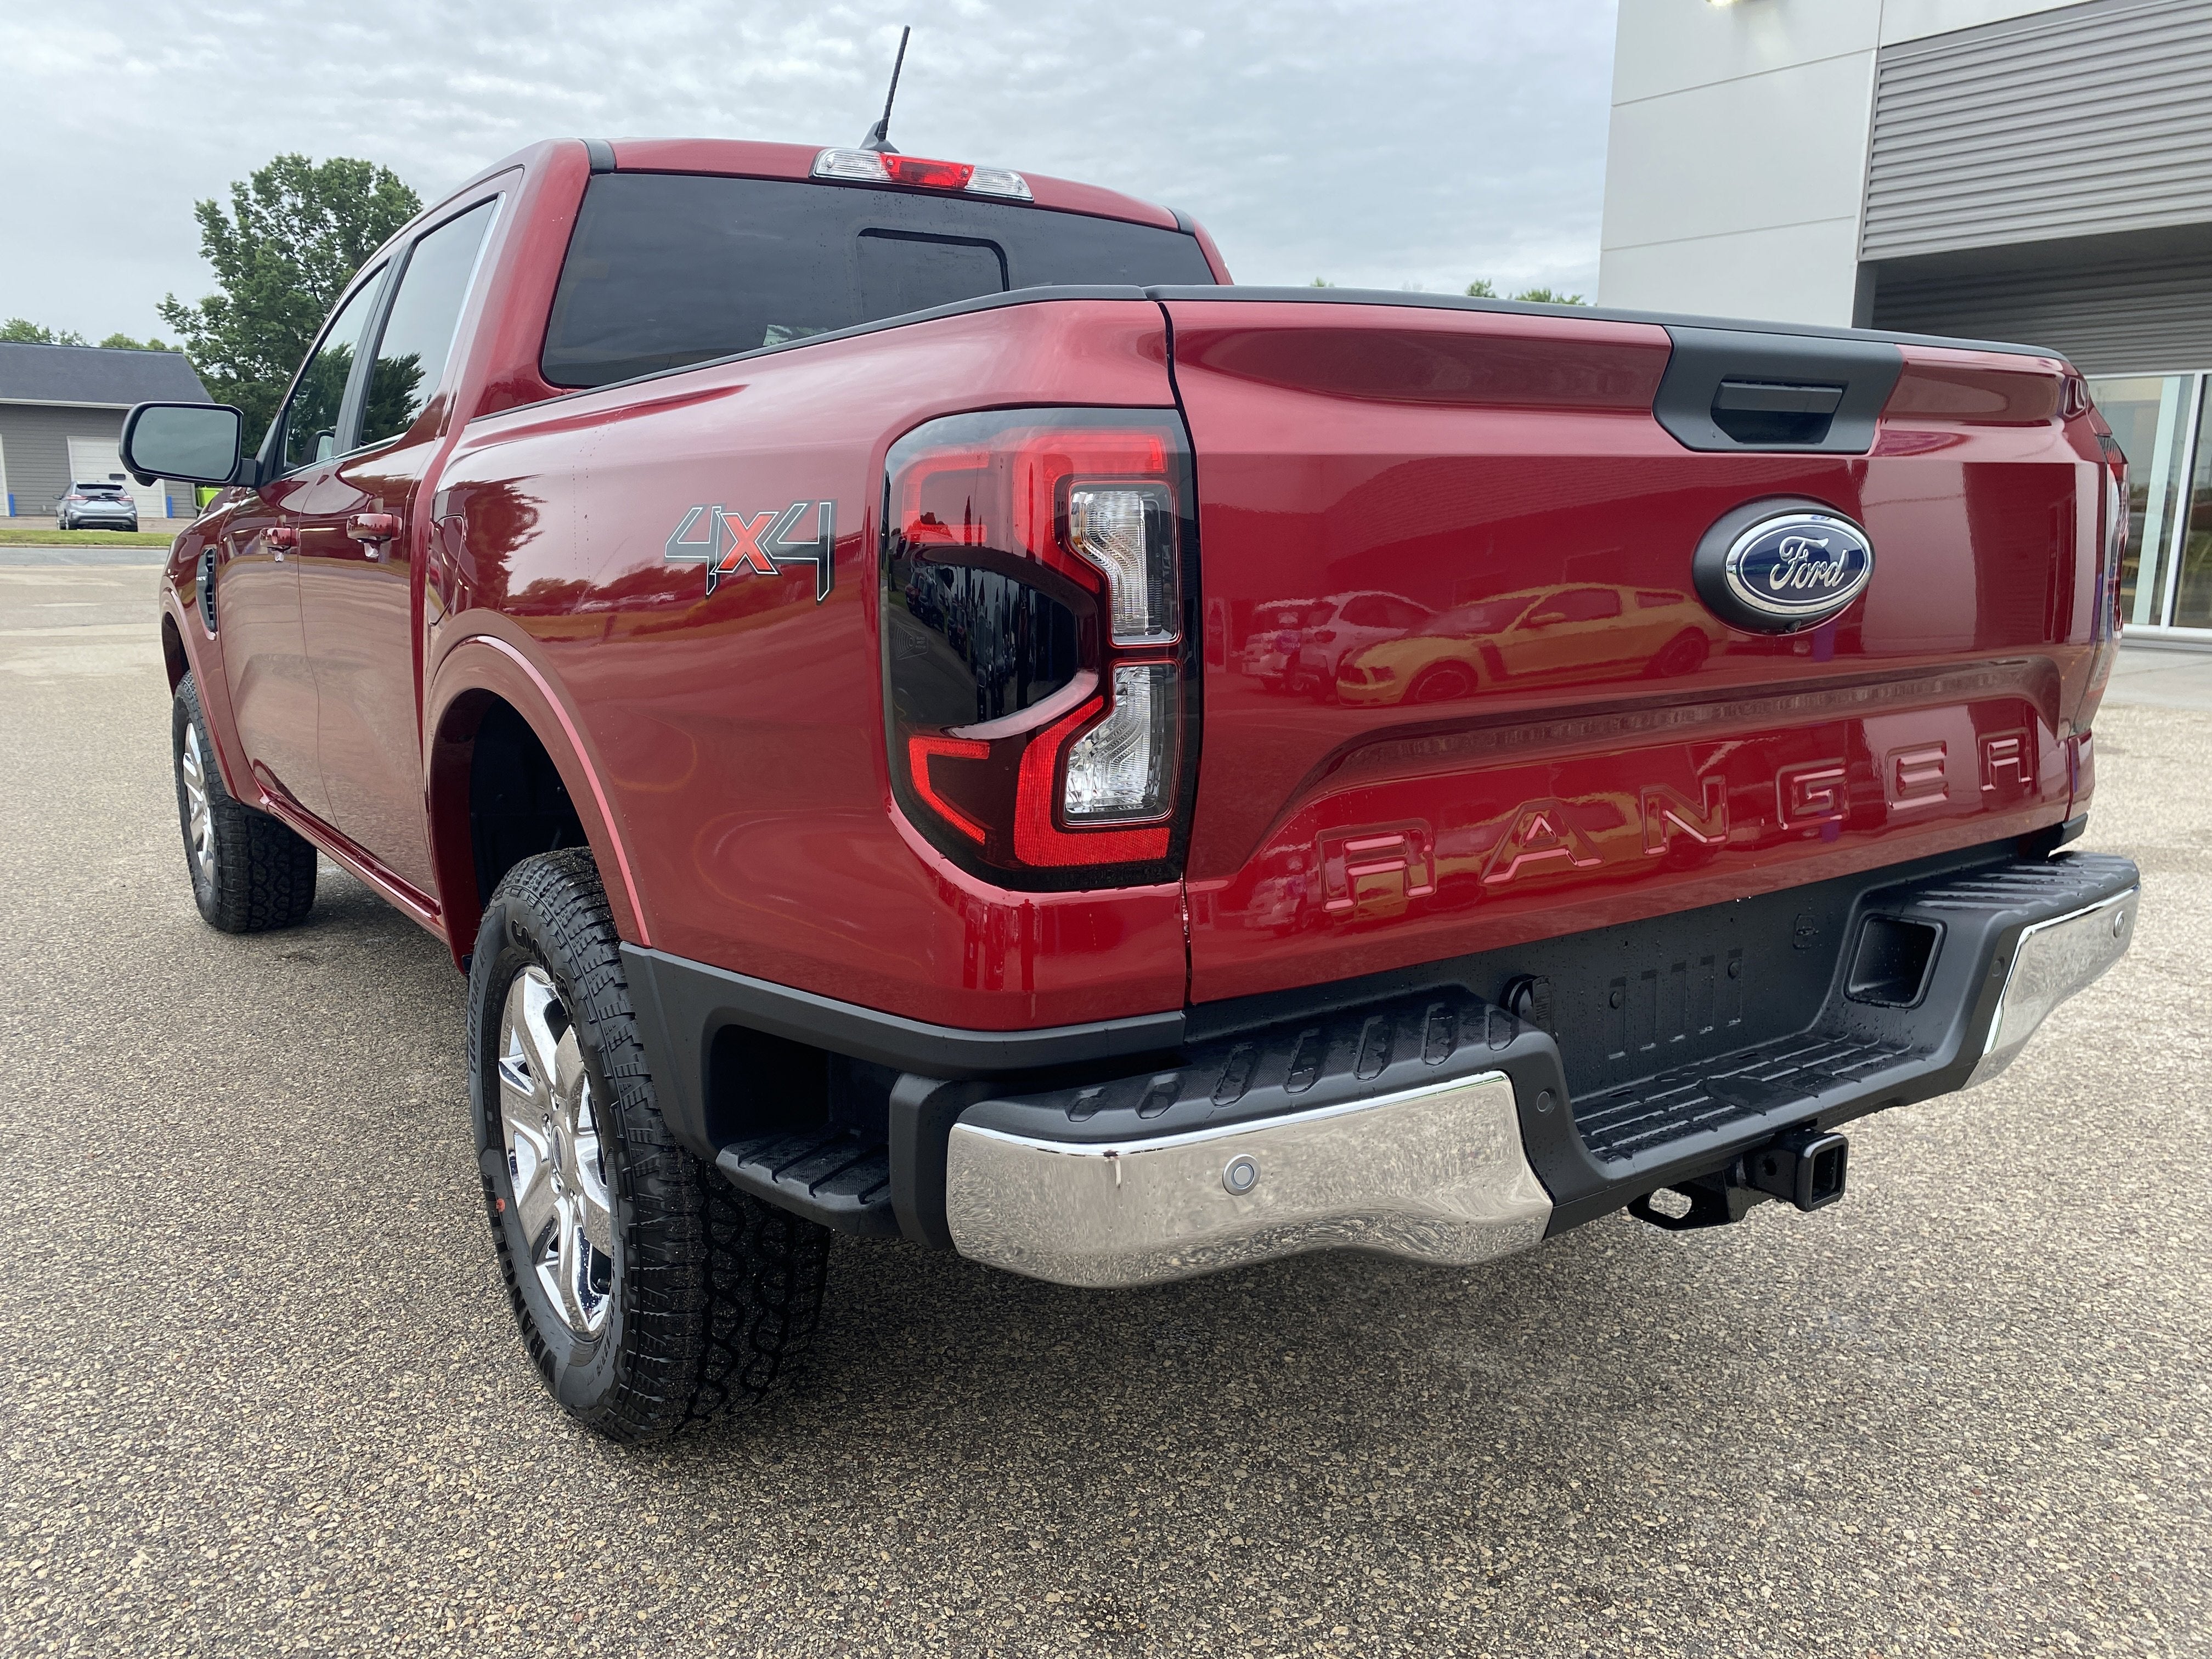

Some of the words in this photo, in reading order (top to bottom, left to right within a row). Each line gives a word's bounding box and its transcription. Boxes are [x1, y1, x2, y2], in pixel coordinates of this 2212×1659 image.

[1769, 535, 1847, 590] Ford
[1317, 729, 2032, 912] RANGER
[469, 968, 482, 1074] TERRITORY
[481, 1173, 557, 1385] WRANGLER
